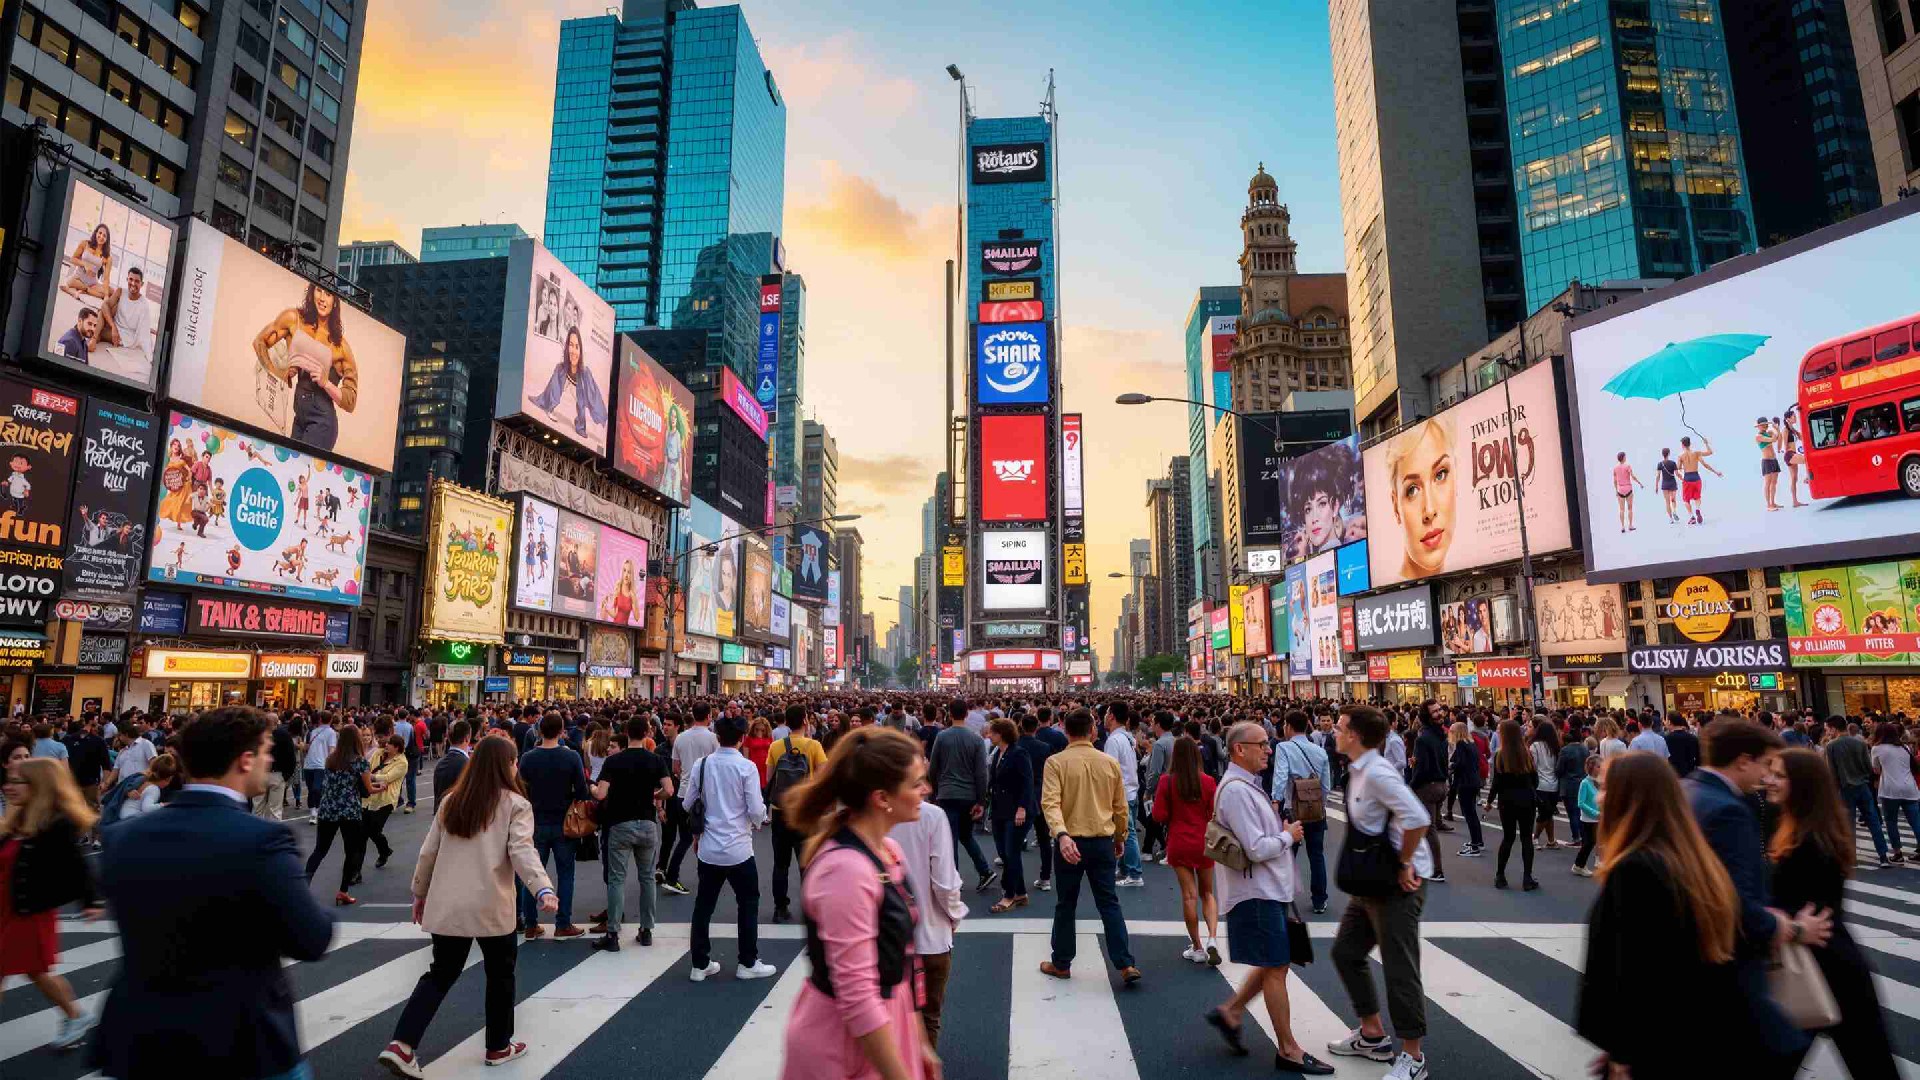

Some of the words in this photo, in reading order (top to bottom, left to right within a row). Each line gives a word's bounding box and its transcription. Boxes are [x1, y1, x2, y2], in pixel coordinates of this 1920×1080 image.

[984, 344, 1041, 364] SHAIR
[0, 510, 61, 546] fun
[1267, 555, 1277, 567] 9
[244, 605, 260, 632] &
[1631, 648, 1689, 669] CLISW
[1481, 666, 1527, 678] MARKS
